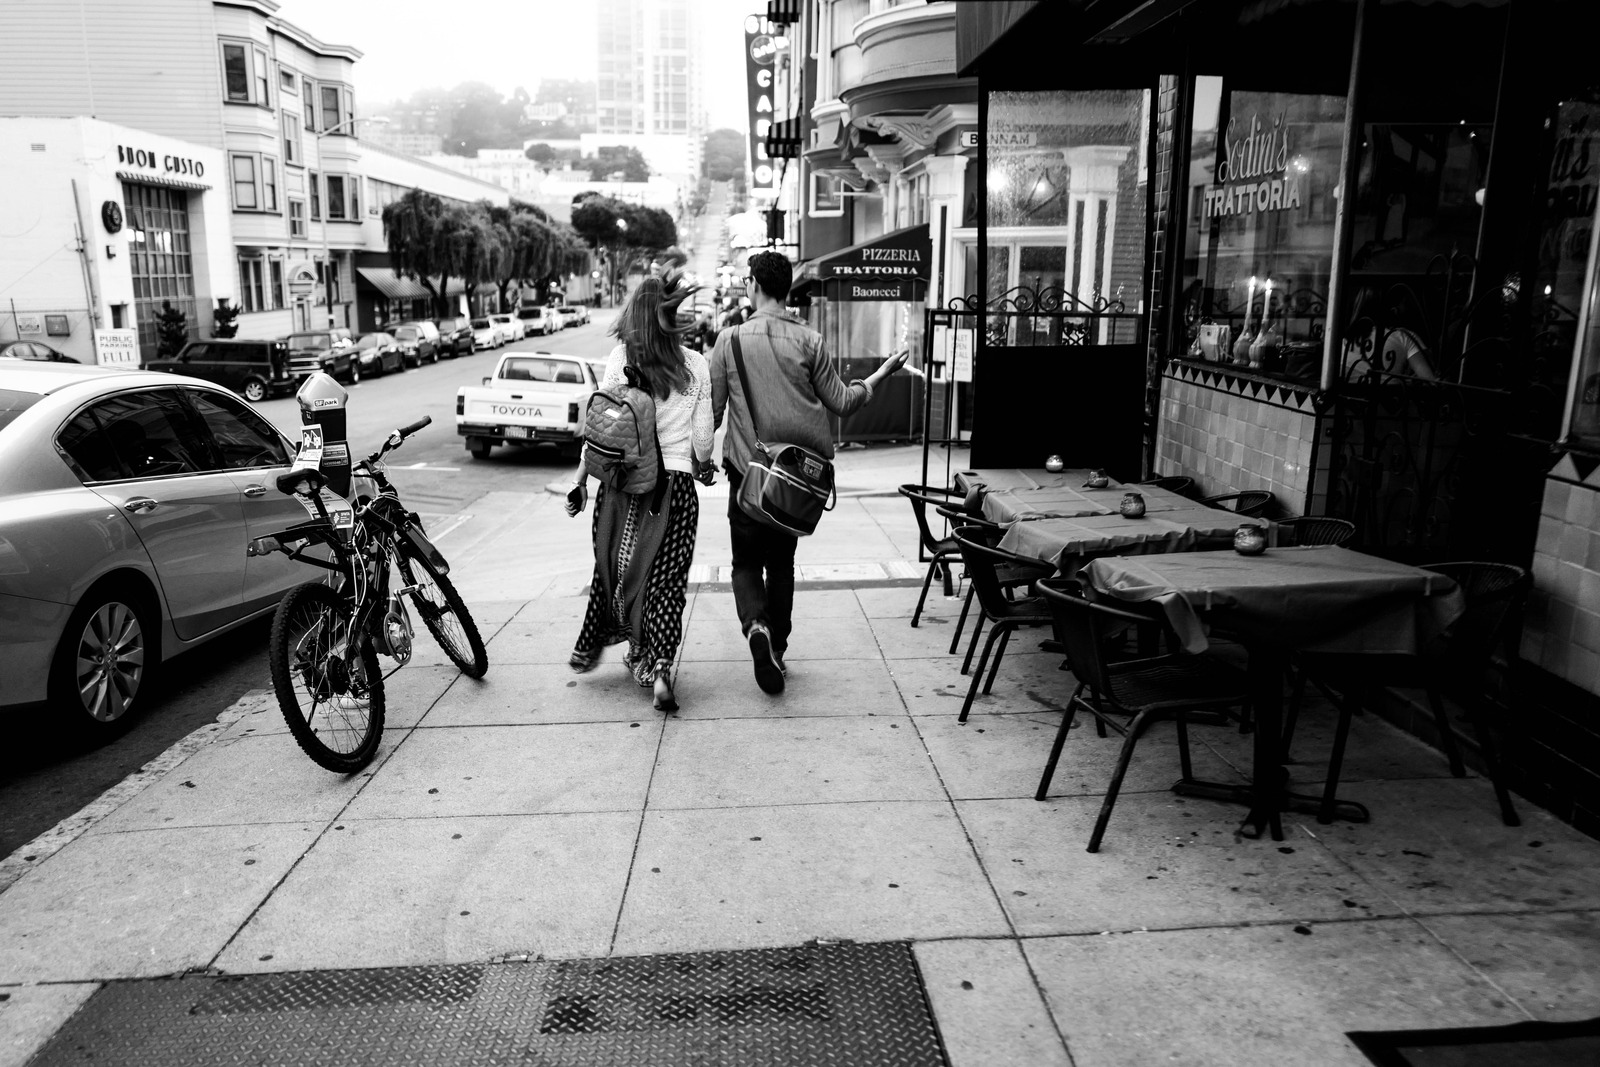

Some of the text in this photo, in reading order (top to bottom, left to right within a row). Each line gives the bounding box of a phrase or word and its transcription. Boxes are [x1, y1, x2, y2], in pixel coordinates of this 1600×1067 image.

[755, 69, 773, 184] CARLO
[970, 134, 1029, 144] BNNAM
[1218, 108, 1289, 183] Sodini's
[118, 145, 204, 178] BUON GUSTO
[1205, 179, 1301, 218] TRATTORIA
[862, 248, 921, 262] PIZZERIA
[833, 266, 918, 275] TRATTORIA
[852, 285, 901, 298] Baonecci
[950, 334, 968, 342] VLET
[103, 351, 135, 362] FULL
[491, 405, 542, 417] TOYOTA
